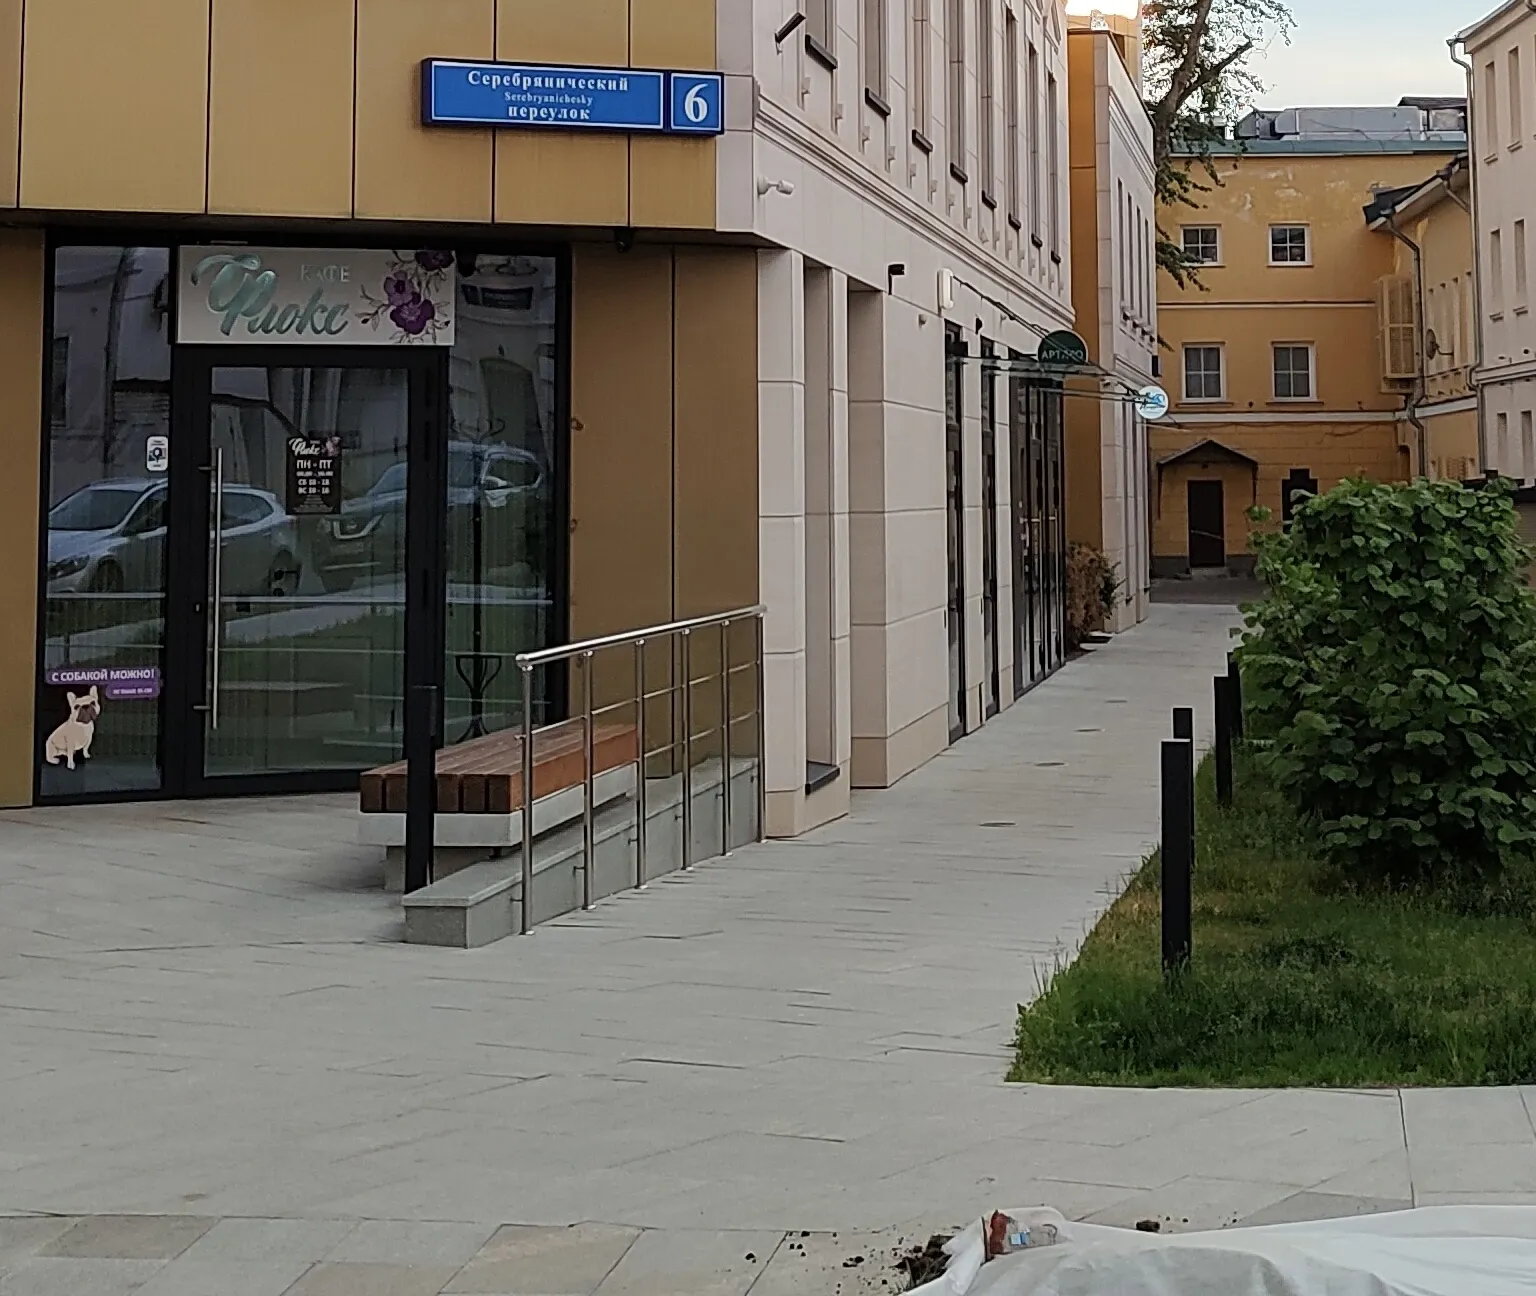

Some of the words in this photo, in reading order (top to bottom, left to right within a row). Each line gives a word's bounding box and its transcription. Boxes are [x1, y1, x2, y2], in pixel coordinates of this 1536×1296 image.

[467, 70, 629, 91] Серебрянический
[504, 91, 593, 106] Serebryanichesky
[684, 83, 708, 122] 6
[508, 105, 591, 120] переулок
[190, 254, 349, 336] Флокс
[51, 672, 59, 682] С
[60, 669, 108, 681] СОБАКОЙ
[110, 668, 155, 680] МОЖНО!
